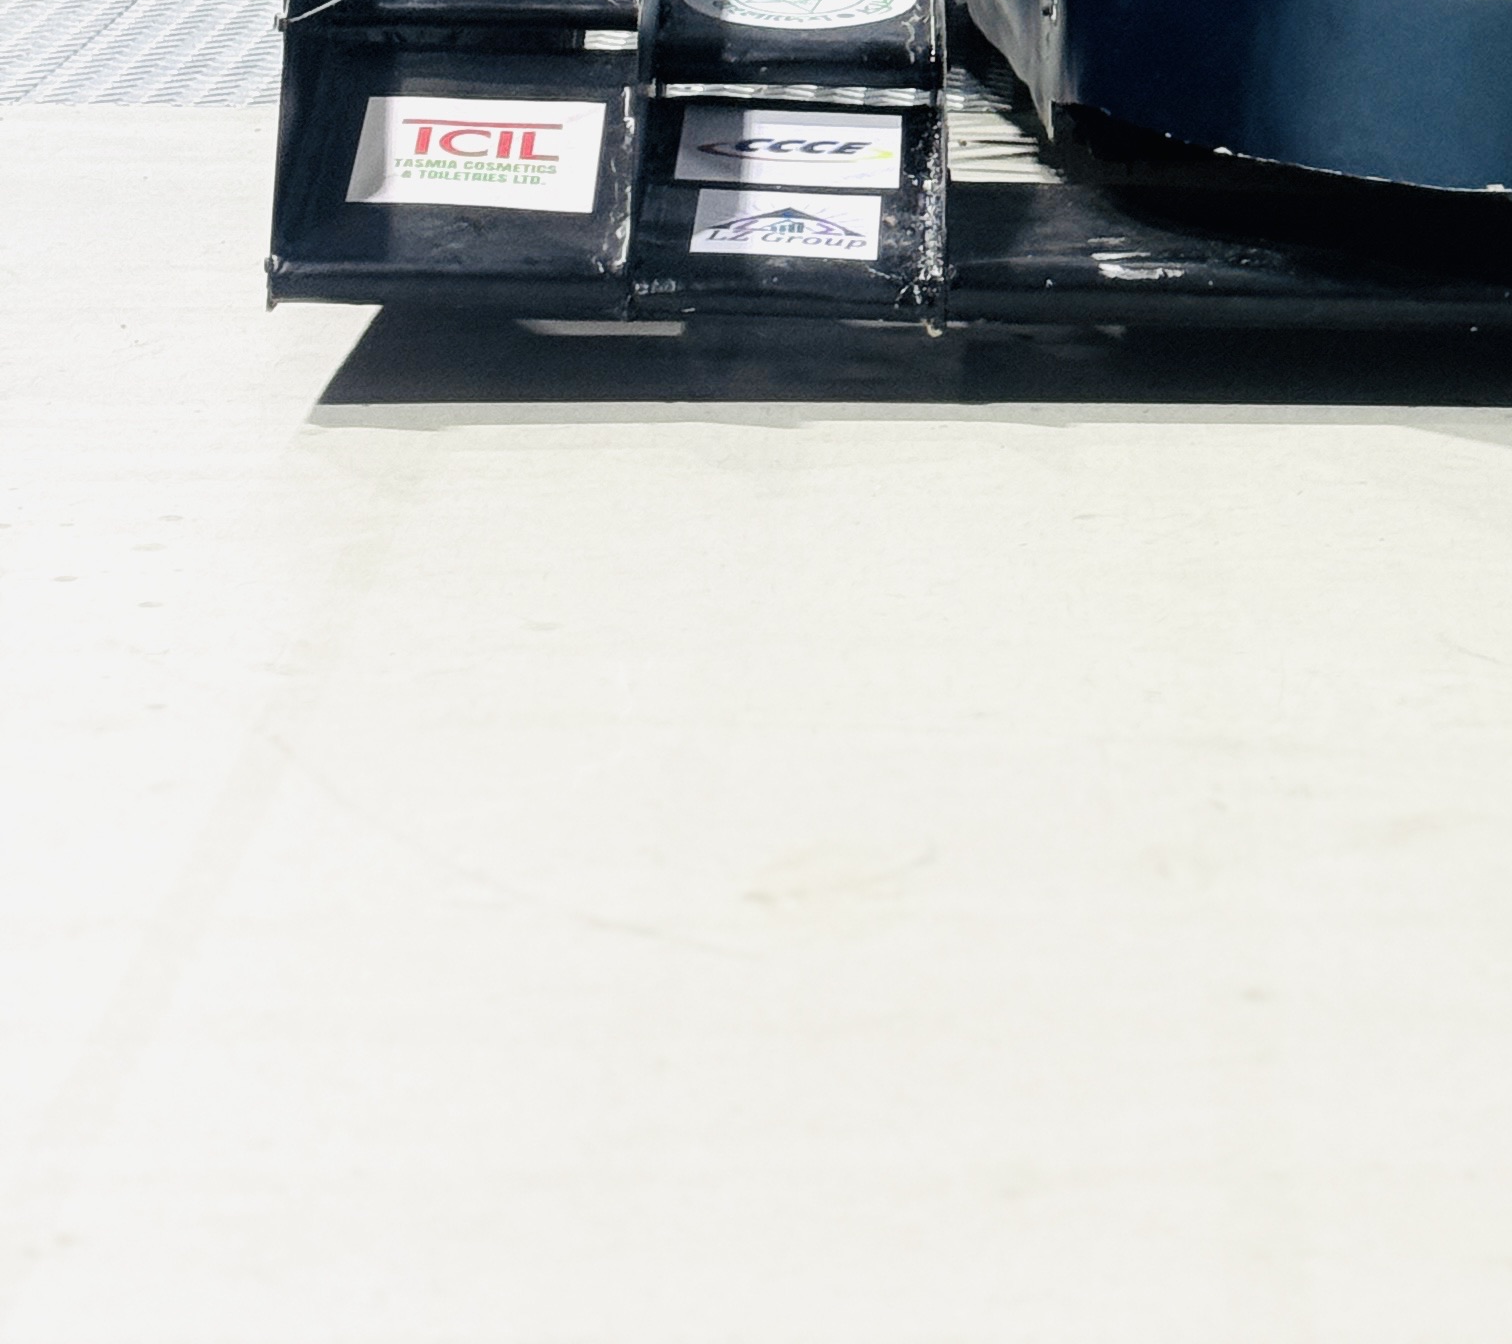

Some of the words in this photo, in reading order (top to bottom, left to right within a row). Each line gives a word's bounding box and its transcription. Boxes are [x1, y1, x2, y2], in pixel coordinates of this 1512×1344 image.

[735, 138, 872, 155] CCCE
[394, 158, 458, 170] TASMIA
[463, 161, 558, 175] COSMETICS
[419, 170, 508, 183] TOILETRIES
[512, 175, 546, 185] LTD.
[761, 232, 868, 251] Group
